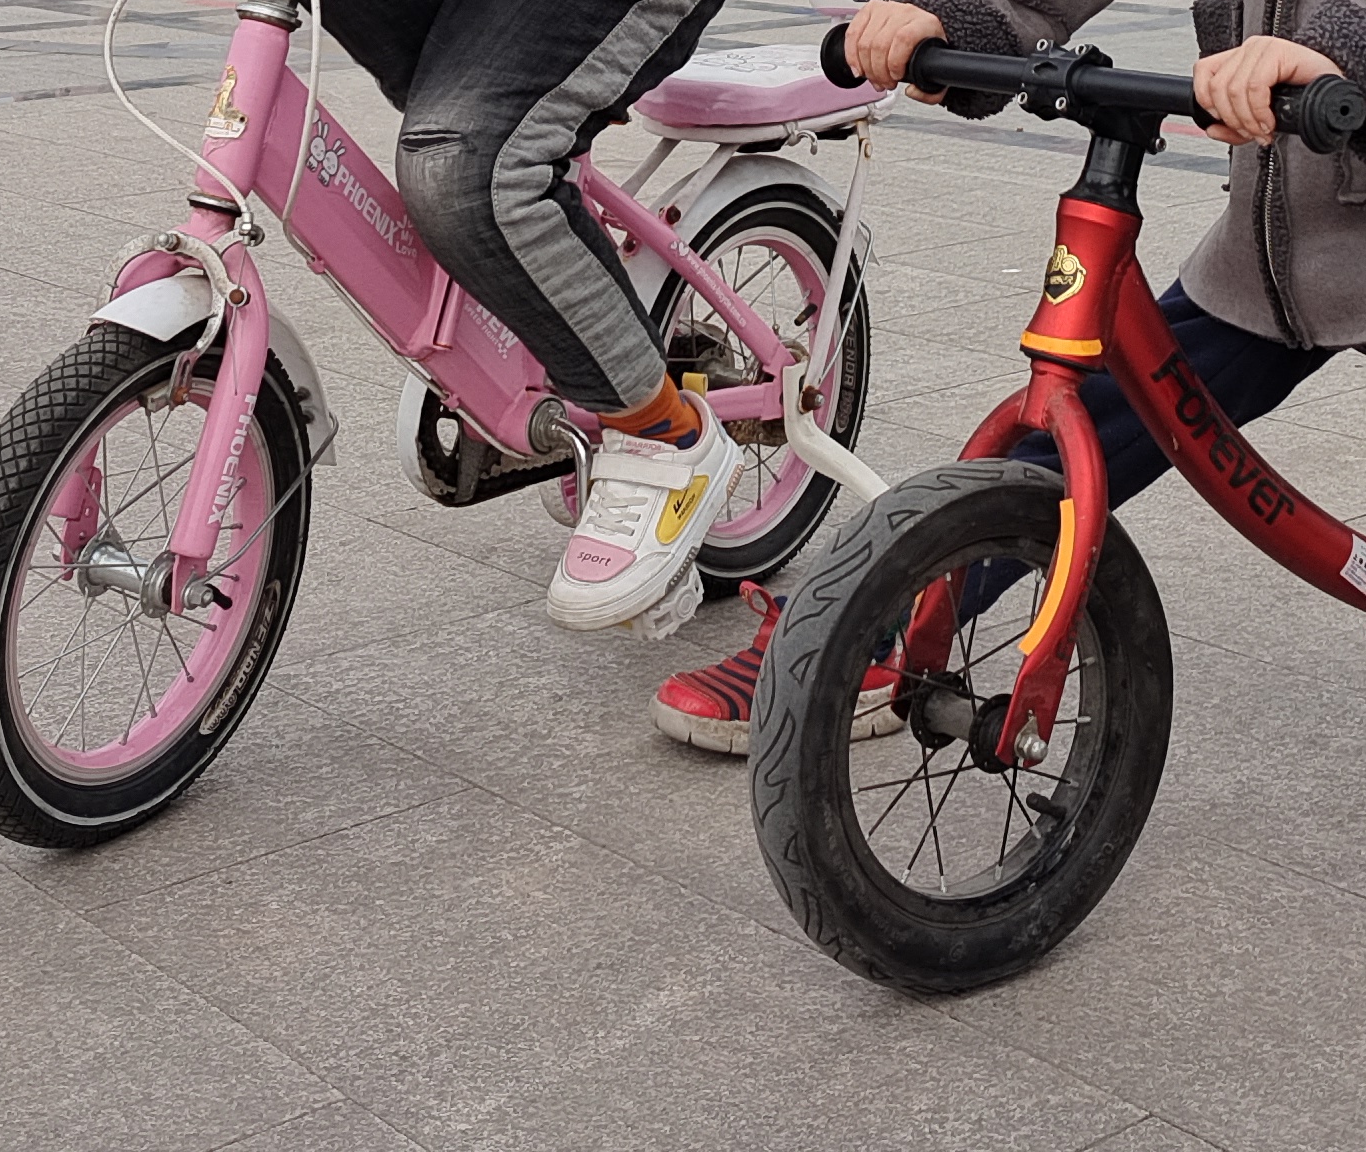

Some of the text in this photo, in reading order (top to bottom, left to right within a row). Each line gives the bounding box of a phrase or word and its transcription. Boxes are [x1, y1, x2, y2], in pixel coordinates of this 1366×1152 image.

[334, 164, 399, 247] PHOENIX
[476, 303, 519, 349] NEW
[207, 394, 257, 525] PHOENIX
[577, 551, 612, 567] sport
